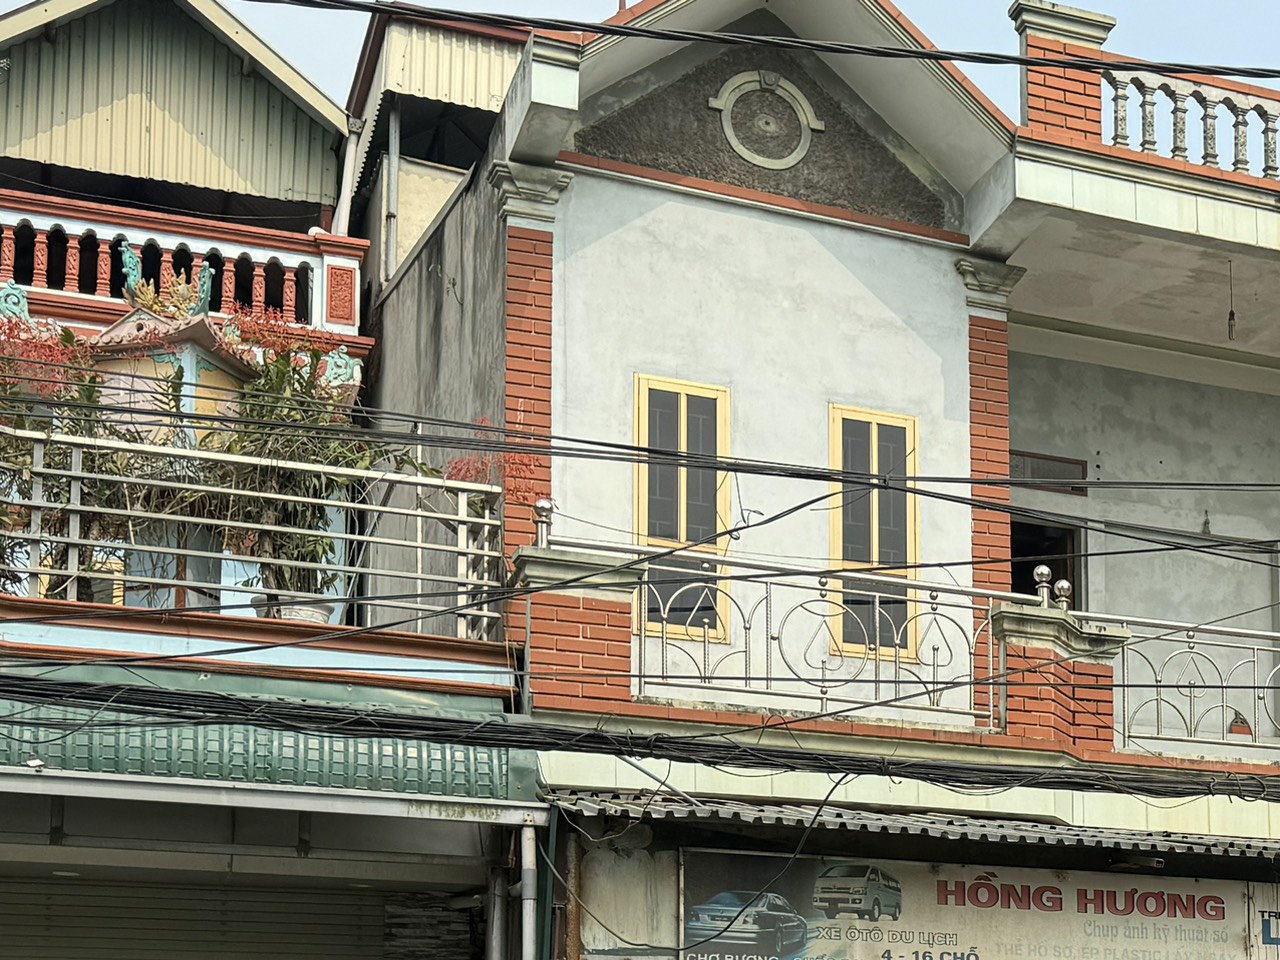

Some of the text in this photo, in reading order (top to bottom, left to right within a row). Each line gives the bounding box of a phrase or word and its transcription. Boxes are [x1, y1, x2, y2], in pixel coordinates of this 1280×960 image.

[936, 871, 1226, 921] HỒNG HƯƠNG
[816, 925, 958, 948] XE ÔTÔ DU LỊCH
[881, 949, 893, 960] 4
